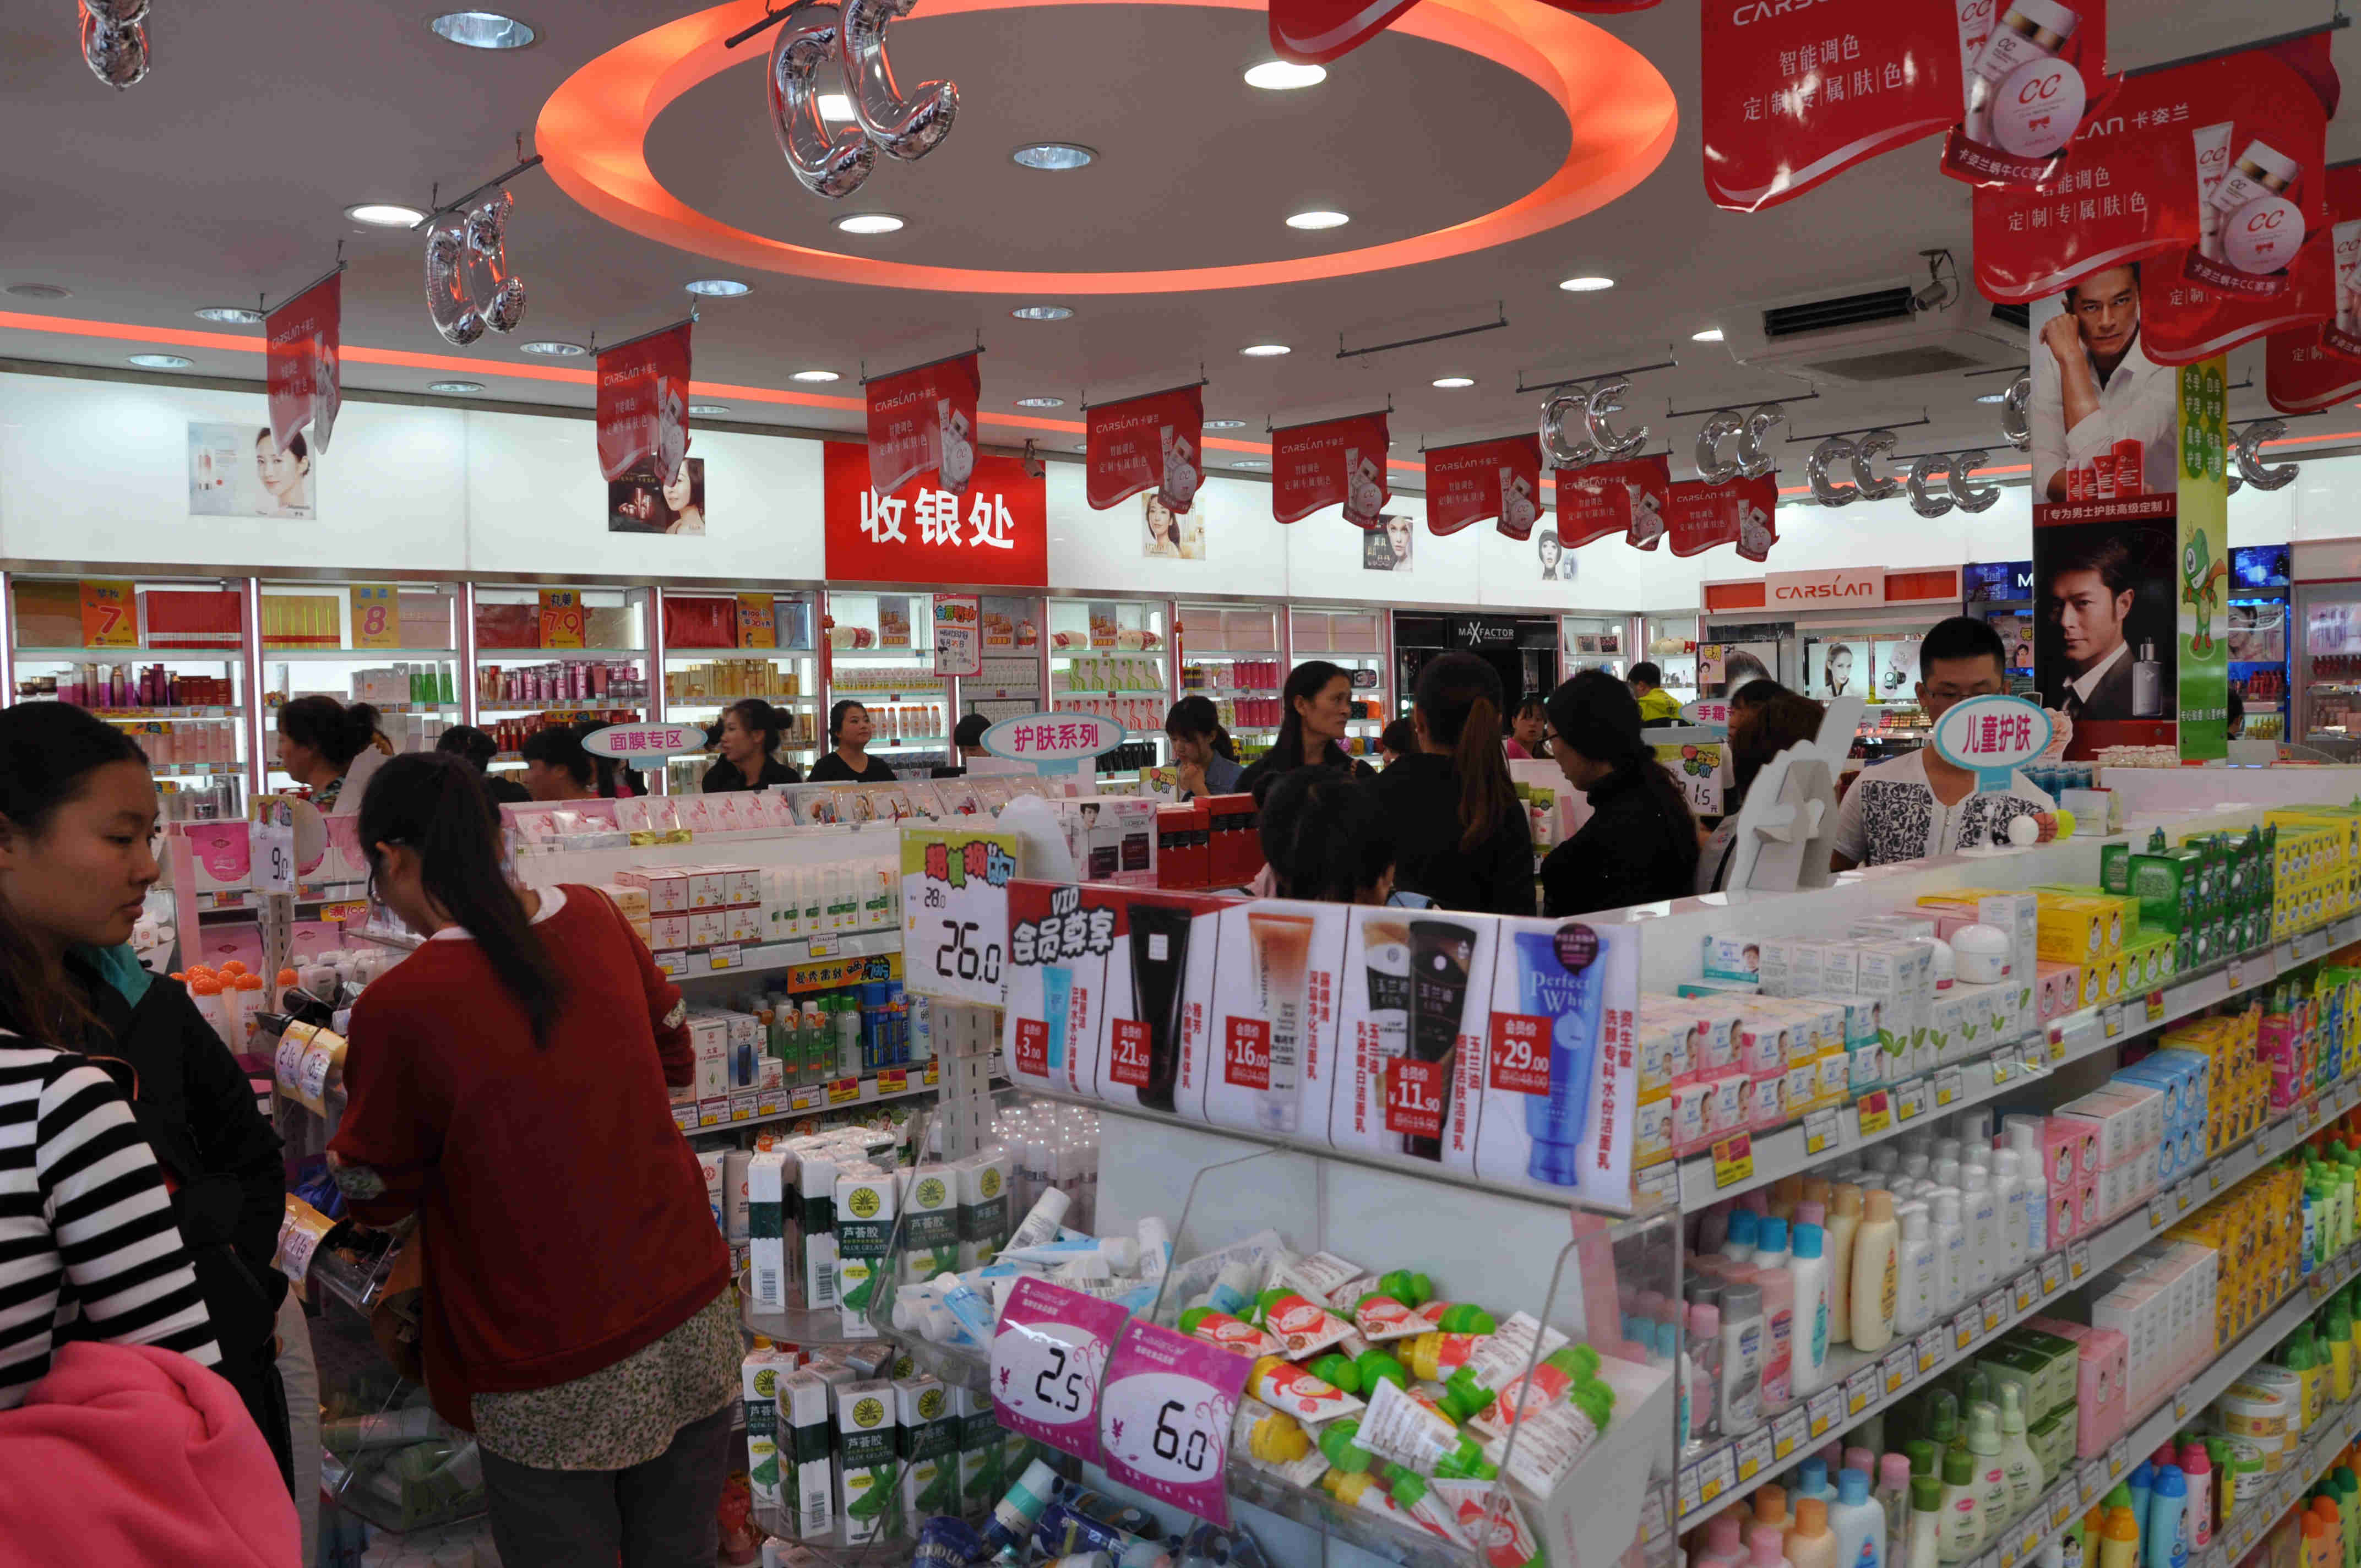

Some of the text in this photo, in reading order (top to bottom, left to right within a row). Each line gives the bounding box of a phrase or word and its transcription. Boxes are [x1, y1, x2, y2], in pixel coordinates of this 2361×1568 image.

[1780, 34, 1860, 77] 智能调色
[2019, 74, 2061, 104] CC
[2131, 103, 2190, 127] 卡姿兰
[2247, 209, 2285, 232] CC
[875, 389, 916, 412] CARSLAN
[1096, 415, 1139, 433] CARSLAN
[1281, 437, 1324, 454] CARSLAN
[1435, 456, 1477, 471] CARSLAN
[1677, 489, 1717, 503] CARSLAN
[860, 486, 1014, 549] 收银处
[1776, 576, 1873, 600] CARSLAN
[98, 606, 123, 634] 7
[364, 605, 387, 635] 8
[609, 729, 683, 751] 面膜专区
[1014, 723, 1099, 752] 护肤系列
[1962, 715, 2031, 754] 儿童护肤
[924, 887, 946, 908] 28.0
[1013, 909, 1113, 962] 会员尊享
[937, 920, 1000, 984] 26.0
[1531, 970, 1591, 996] Perfect
[1505, 1019, 1537, 1037] 会员价
[1619, 1010, 1633, 1068] 资生堂
[1399, 1065, 1428, 1082] 会员价
[842, 1226, 879, 1239] 芦荟胶
[910, 1215, 945, 1231] 芦荟胶
[1035, 1347, 1083, 1413] 2.5
[847, 1435, 883, 1448] 芦荟胶
[1153, 1400, 1206, 1472] 6.0
